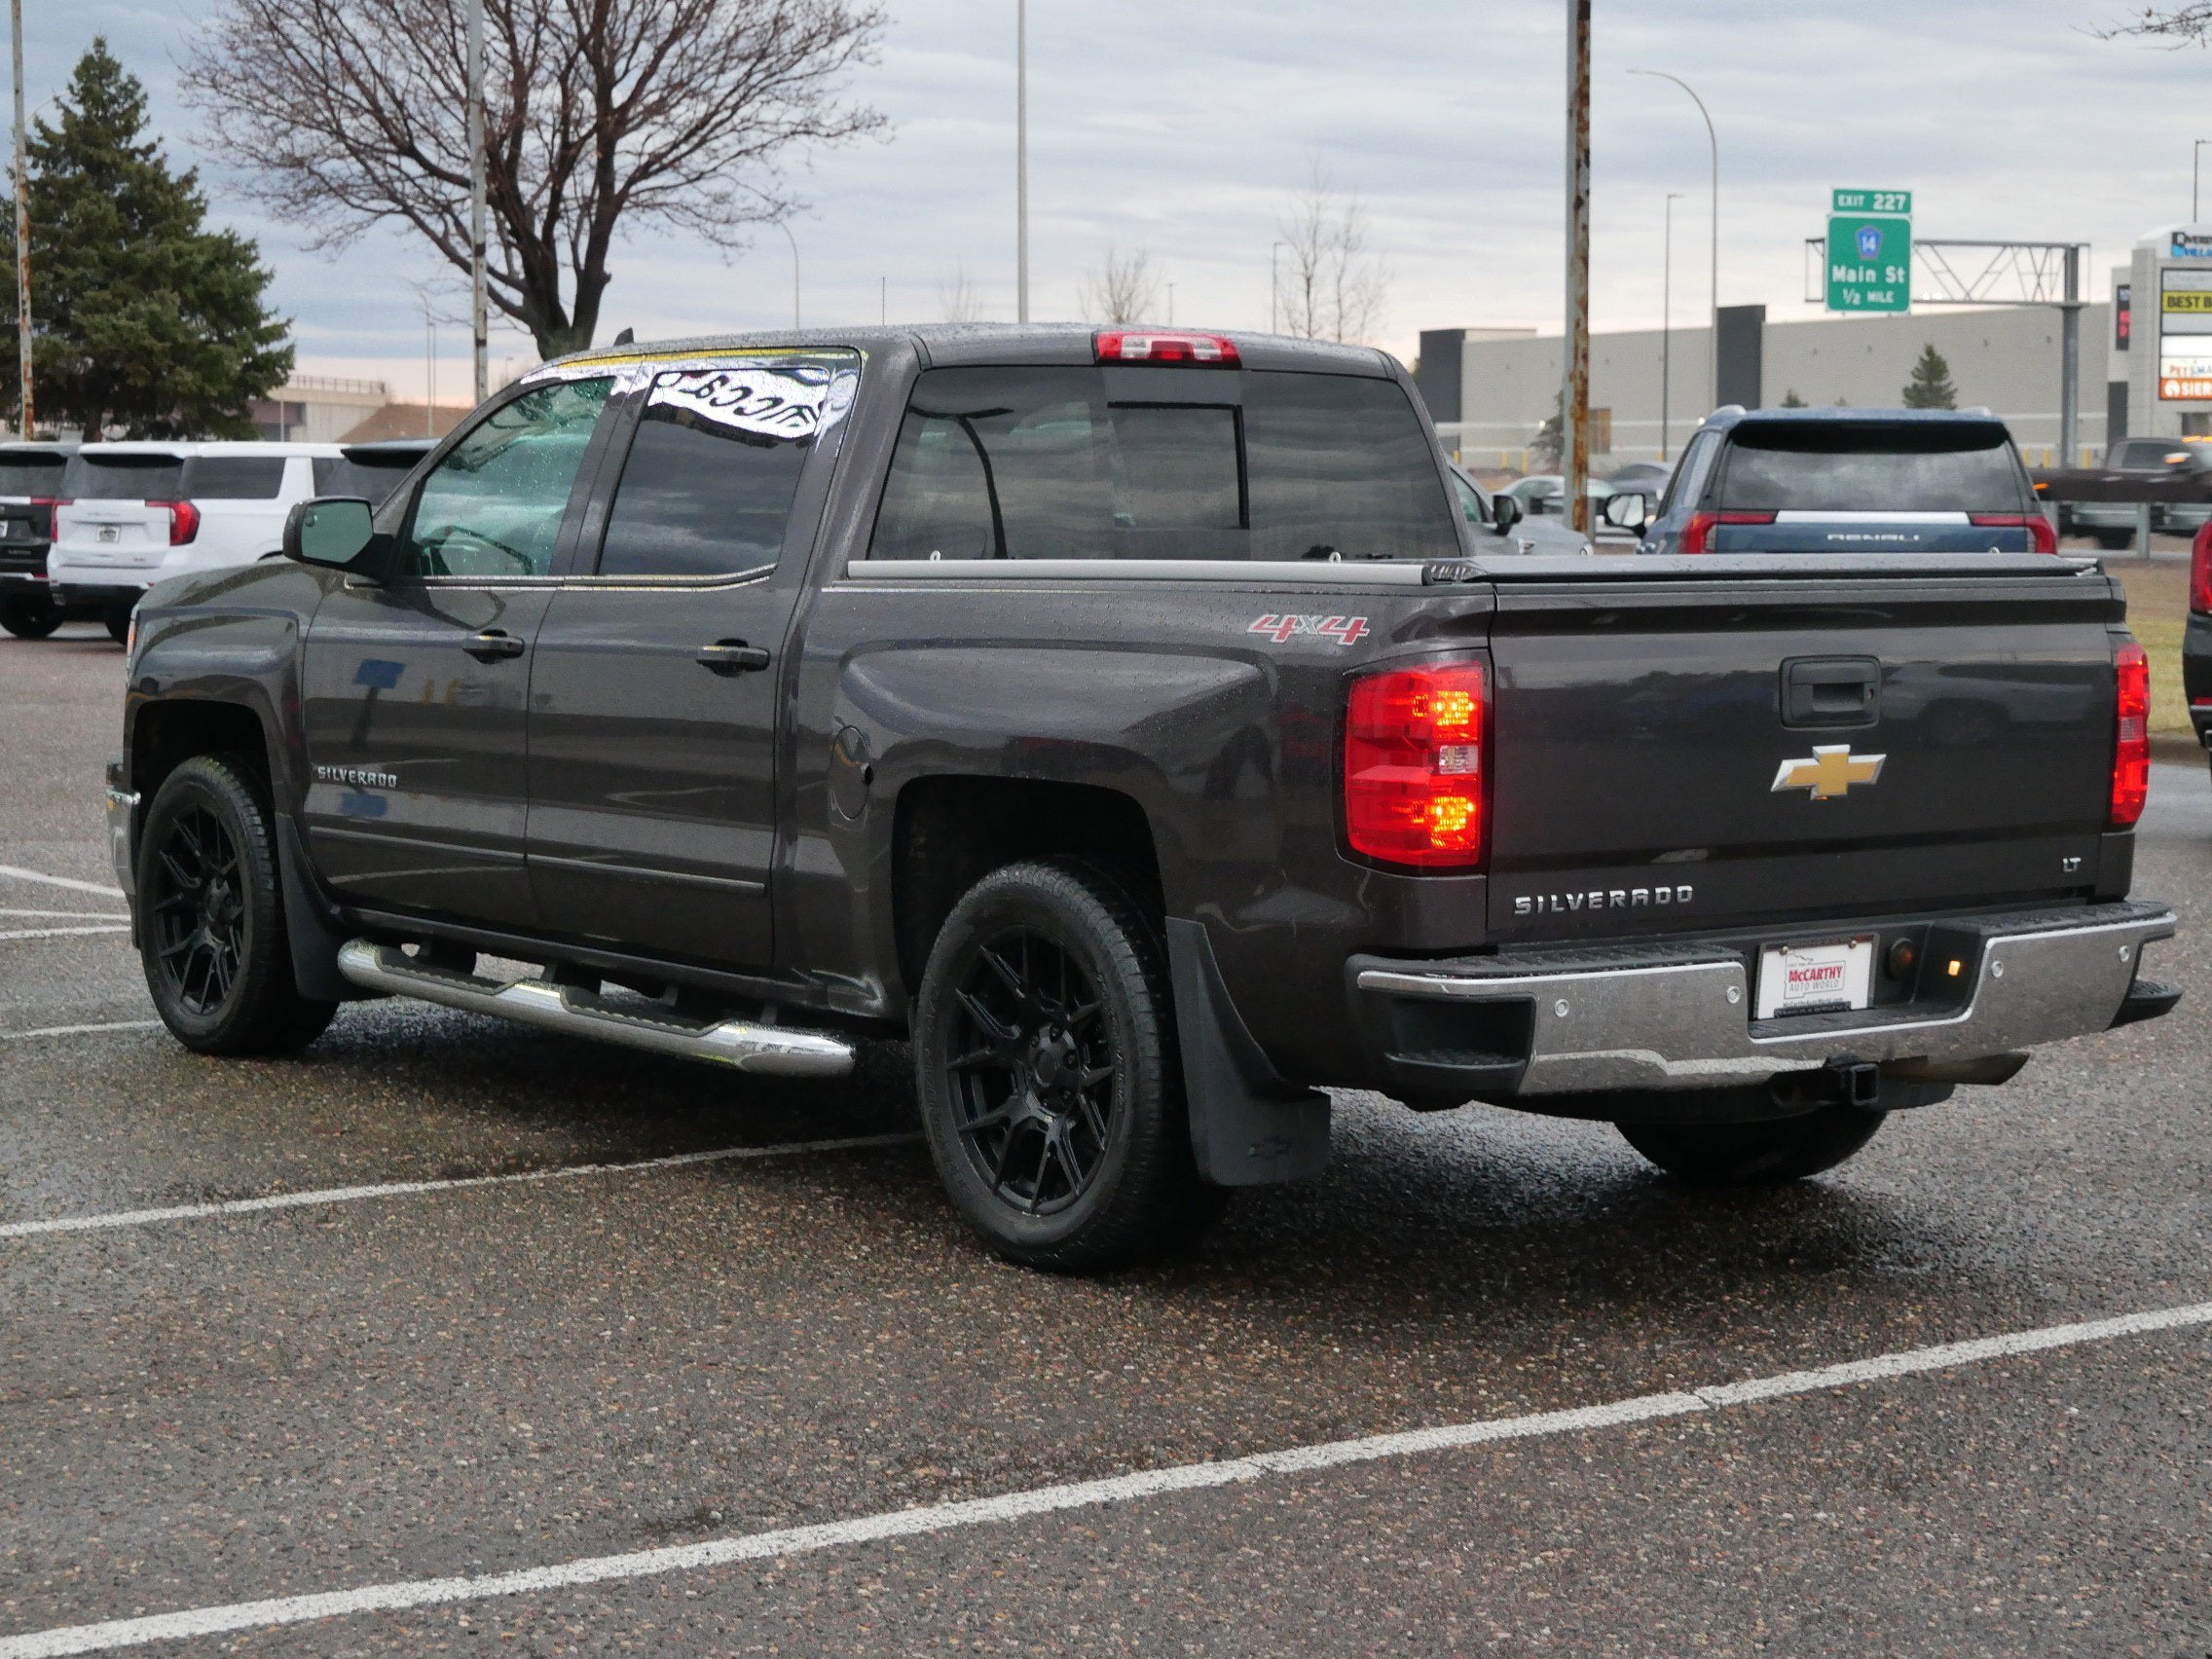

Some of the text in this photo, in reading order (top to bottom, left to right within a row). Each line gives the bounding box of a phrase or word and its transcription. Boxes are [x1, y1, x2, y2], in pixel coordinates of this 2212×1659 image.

[1837, 193, 1906, 210] EXIT 227
[1861, 236, 1877, 252] 14
[1831, 264, 1905, 284] Main St
[1866, 290, 1895, 304] MILE
[2167, 296, 2199, 308] BEST
[317, 765, 397, 789] SILVERADO
[2062, 857, 2082, 872] LT
[1514, 885, 1693, 915] SILVERADO
[1788, 965, 1843, 983] McCARTHY
[1789, 979, 1839, 992] AUTO WORLD
